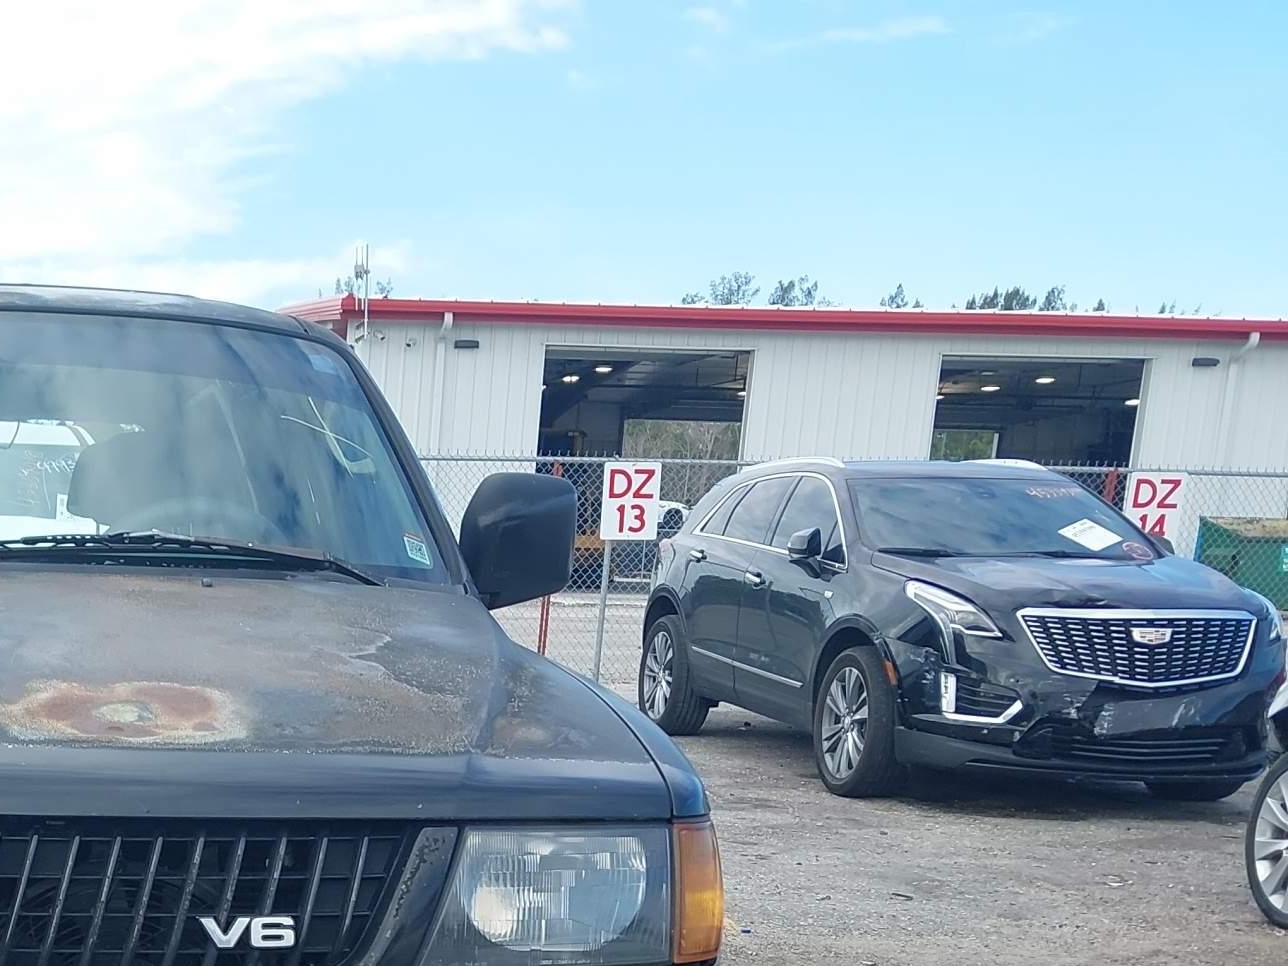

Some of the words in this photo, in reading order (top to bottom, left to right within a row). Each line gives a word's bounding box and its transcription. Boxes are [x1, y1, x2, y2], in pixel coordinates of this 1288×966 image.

[609, 468, 656, 499] DZ
[1133, 478, 1182, 508] DZ
[616, 504, 646, 533] 13
[197, 916, 295, 948] V6
